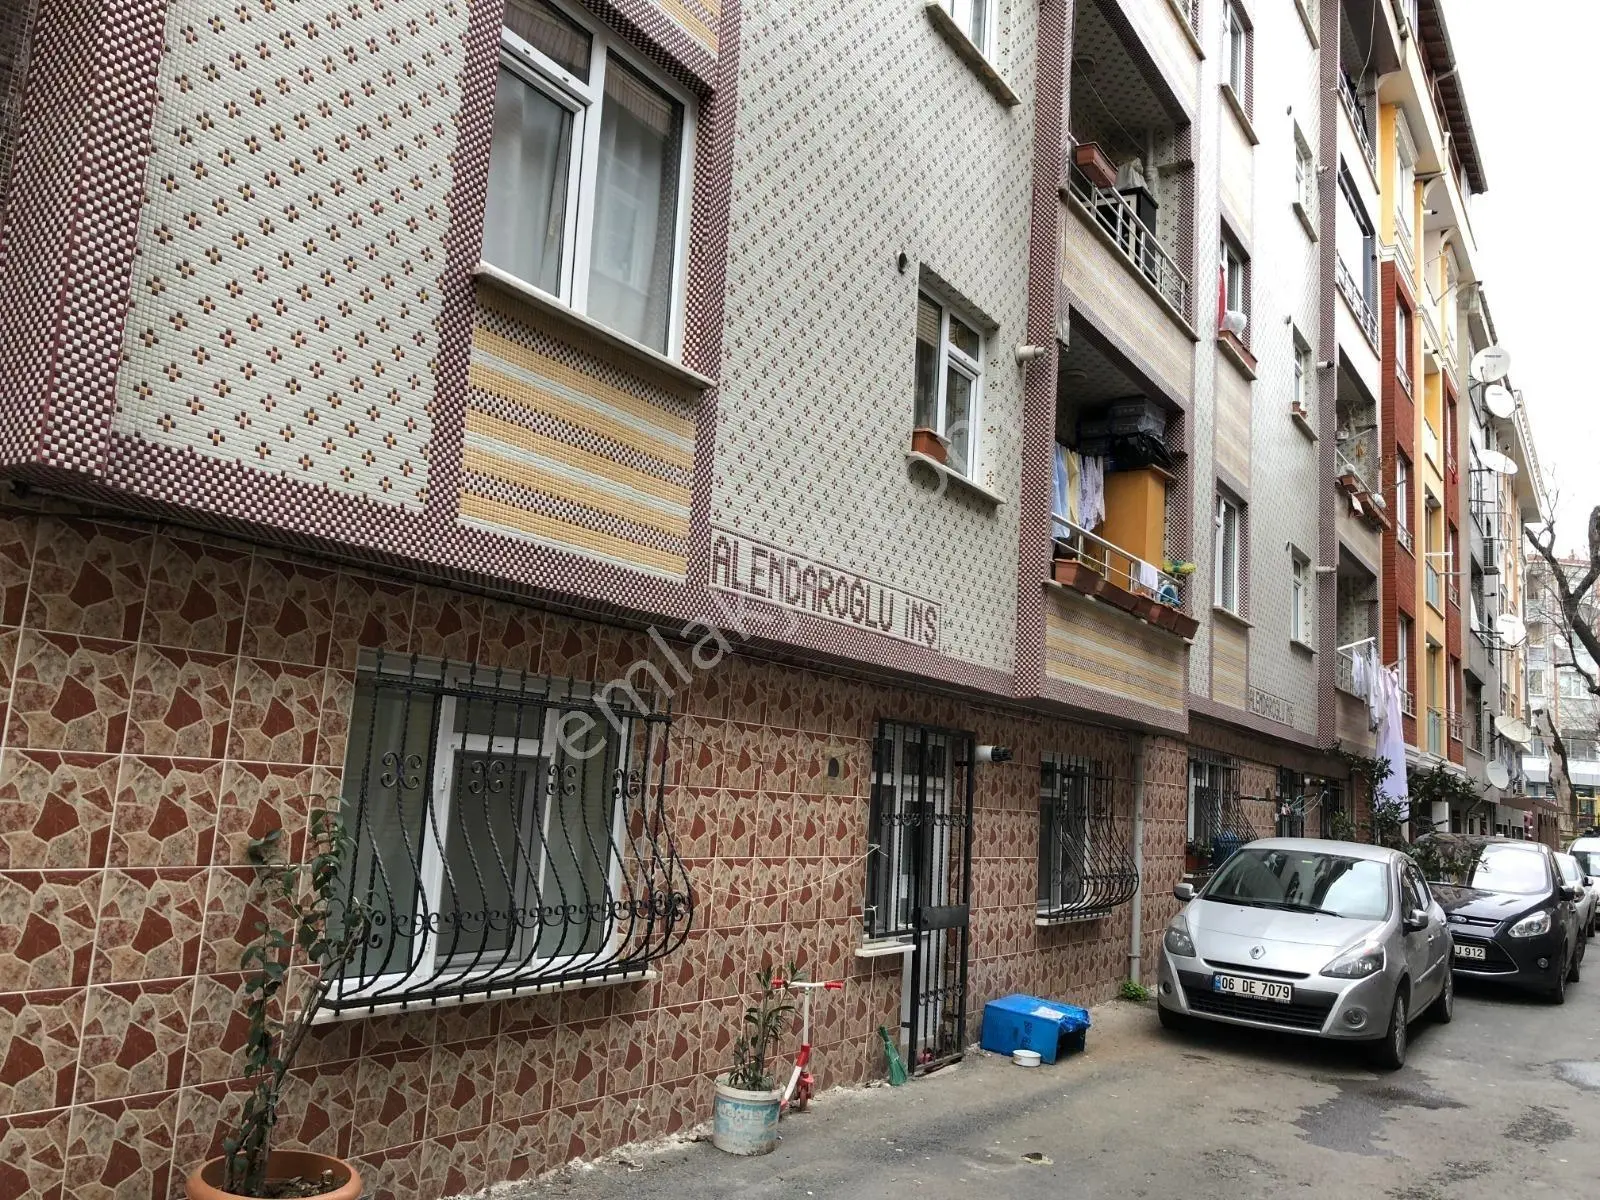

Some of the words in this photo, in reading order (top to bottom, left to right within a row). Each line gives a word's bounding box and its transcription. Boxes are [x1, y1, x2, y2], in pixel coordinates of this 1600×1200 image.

[1465, 947, 1483, 957] 912
[1222, 977, 1235, 990] 06
[1242, 979, 1256, 994] DE
[1262, 983, 1290, 998] 7079
